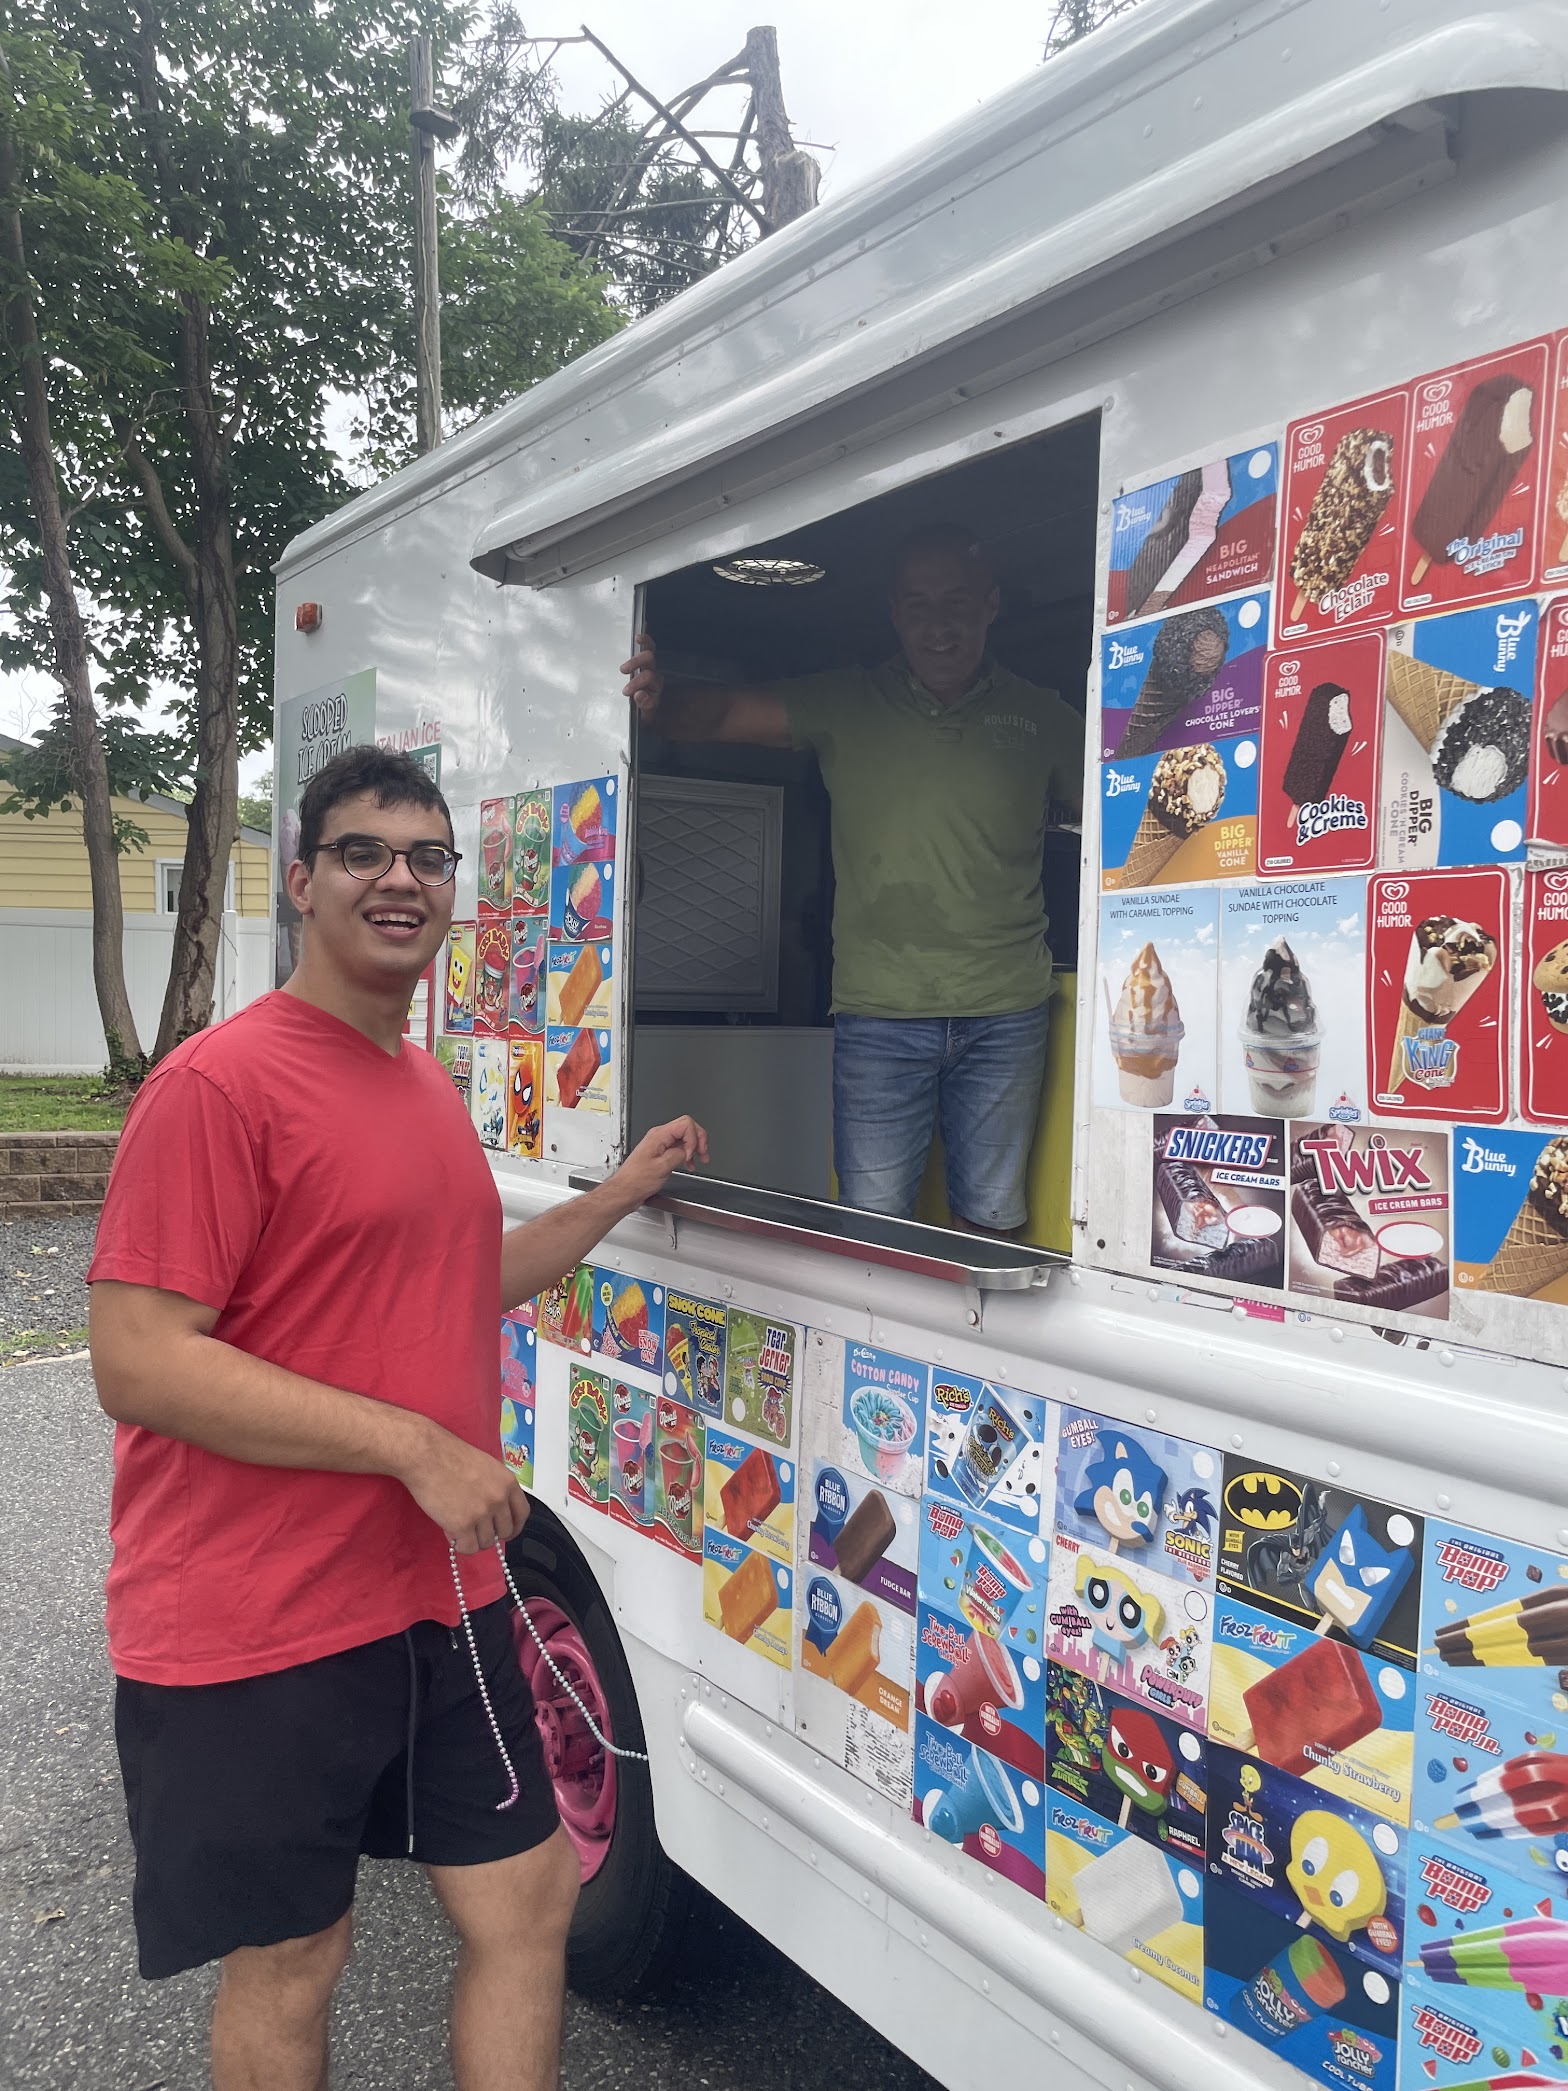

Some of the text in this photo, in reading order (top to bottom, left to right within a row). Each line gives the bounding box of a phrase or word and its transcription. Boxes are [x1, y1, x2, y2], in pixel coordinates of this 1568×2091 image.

[1422, 400, 1450, 418] GOOD
[1416, 412, 1454, 433] HUMOR
[1298, 443, 1322, 460] GOOD
[1293, 454, 1325, 473] HUMOR
[1219, 539, 1248, 560] BIG
[1447, 537, 1468, 556] The
[1456, 528, 1523, 564] Original
[1206, 552, 1259, 574] NEAPOLITAN
[1206, 563, 1259, 585] SANDWICH
[1319, 573, 1388, 614] Chocolate
[1336, 591, 1374, 622] Eclair
[1275, 685, 1301, 699] HUMOR
[1278, 675, 1299, 688] GOOD
[1211, 687, 1235, 703] BIG
[302, 692, 348, 741] SCOOPED
[1185, 706, 1260, 727] CHOCOLATE LOVER'S
[1205, 699, 1241, 715] DIPPER
[985, 714, 1037, 735] HOLLISTER
[1209, 719, 1235, 731] CONE
[377, 720, 441, 755] ITALIAN ICE
[298, 746, 315, 785] ICE
[1400, 772, 1409, 814] COOKIES
[1298, 794, 1364, 826] Cookies
[1390, 800, 1399, 837] CONE
[1408, 790, 1419, 843] DIPPER
[1419, 798, 1433, 834] BIG
[1220, 824, 1246, 840] BIG
[1311, 814, 1367, 836] Creme
[1214, 836, 1252, 851] DIPPER
[1217, 849, 1249, 859] VANILLA
[1398, 830, 1406, 864] CREAM
[1219, 857, 1246, 867] CONE
[1121, 894, 1180, 906] VANILLA SUNDAE
[1239, 882, 1326, 898] VANILLA CHOCOLATE
[1543, 892, 1568, 906] GOO
[1110, 906, 1194, 919] WITH CARAMEL TOPPING
[1228, 895, 1338, 913] SUNDAE WITH CHOCOLATE
[1381, 901, 1407, 914] GOOD
[1537, 906, 1568, 920] HUM
[1262, 912, 1299, 924] TOPPING
[1377, 915, 1412, 928] HUMOR
[1414, 1069, 1445, 1081] Cone
[1167, 1129, 1268, 1166] SNICKERS
[1216, 1172, 1280, 1186] ICE CREAM BARS
[1375, 1197, 1442, 1211] ICE CREAM BARS
[668, 1293, 727, 1327] SNOW CONE
[766, 1328, 787, 1351] Tear
[758, 1347, 791, 1374] Jerker
[851, 1359, 920, 1392] COTTON CANDY
[907, 1391, 920, 1404] Cup
[936, 1386, 970, 1409] Rich's
[988, 1407, 1014, 1439] Rich's
[1062, 1418, 1099, 1438] GUMBALL
[1070, 1432, 1096, 1449] EYES!
[824, 1479, 841, 1492] BLUE
[819, 1486, 846, 1512] RIBBON
[928, 1505, 964, 1531] BOMB
[931, 1521, 958, 1539] POP
[1055, 1535, 1081, 1554] CHERRY
[1165, 1530, 1211, 1560] SONIC
[1451, 1539, 1500, 1560] THE ORIGINAL
[1220, 1558, 1240, 1570] CHERRY
[1438, 1542, 1509, 1580] BOMB
[977, 1566, 1006, 1597] BOMB
[1220, 1567, 1243, 1581] FLAVORED
[1443, 1562, 1498, 1592] POP
[816, 1587, 833, 1603] BLUE
[880, 1576, 912, 1599] FUDGE BAR
[976, 1578, 1000, 1599] POP
[811, 1594, 838, 1621] RIBBON
[965, 1583, 1001, 1622] Watermelon
[1060, 1605, 1078, 1616] with
[928, 1614, 965, 1645] Two-Ball
[1050, 1614, 1092, 1629] GUMBALL
[1141, 1665, 1203, 1708] POWERPUFF
[1149, 1687, 1174, 1705] GIRLS
[879, 1687, 903, 1708] ORANGE
[879, 1696, 901, 1714] DREAM
[1450, 1697, 1482, 1714] ORIGINAL
[1427, 1695, 1489, 1732] BOMB
[1432, 1717, 1502, 1756] POP JR.
[1051, 1762, 1089, 1797] TURTLES
[1303, 1744, 1341, 1774] Chunky
[1343, 1763, 1400, 1802] Strawberry
[1168, 1826, 1201, 1848] RAPHAEL
[1229, 1811, 1265, 1844] SPACE
[1230, 1857, 1244, 1869] NEW
[1434, 1856, 1484, 1883] THE ORIGINAL
[1421, 1856, 1492, 1902] BOMB
[1427, 1880, 1481, 1913] POP
[1367, 1928, 1397, 1940] GUMBALL
[1371, 1921, 1389, 1931] WITH
[1376, 1937, 1392, 1947] EYES!
[1132, 1936, 1201, 1987] Creamy Coconut
[1242, 1989, 1254, 2012] COOL
[1254, 1986, 1295, 2029] rancher
[1256, 1976, 1295, 2021] JOLLY
[1413, 2005, 1483, 2054] BOMB
[1426, 2006, 1475, 2034] THE ORIGINAL
[1334, 2041, 1370, 2065] JOLLY
[1420, 2030, 1474, 2065] POP
[1322, 2060, 1345, 2080] COOL
[1337, 2054, 1373, 2076] rancher
